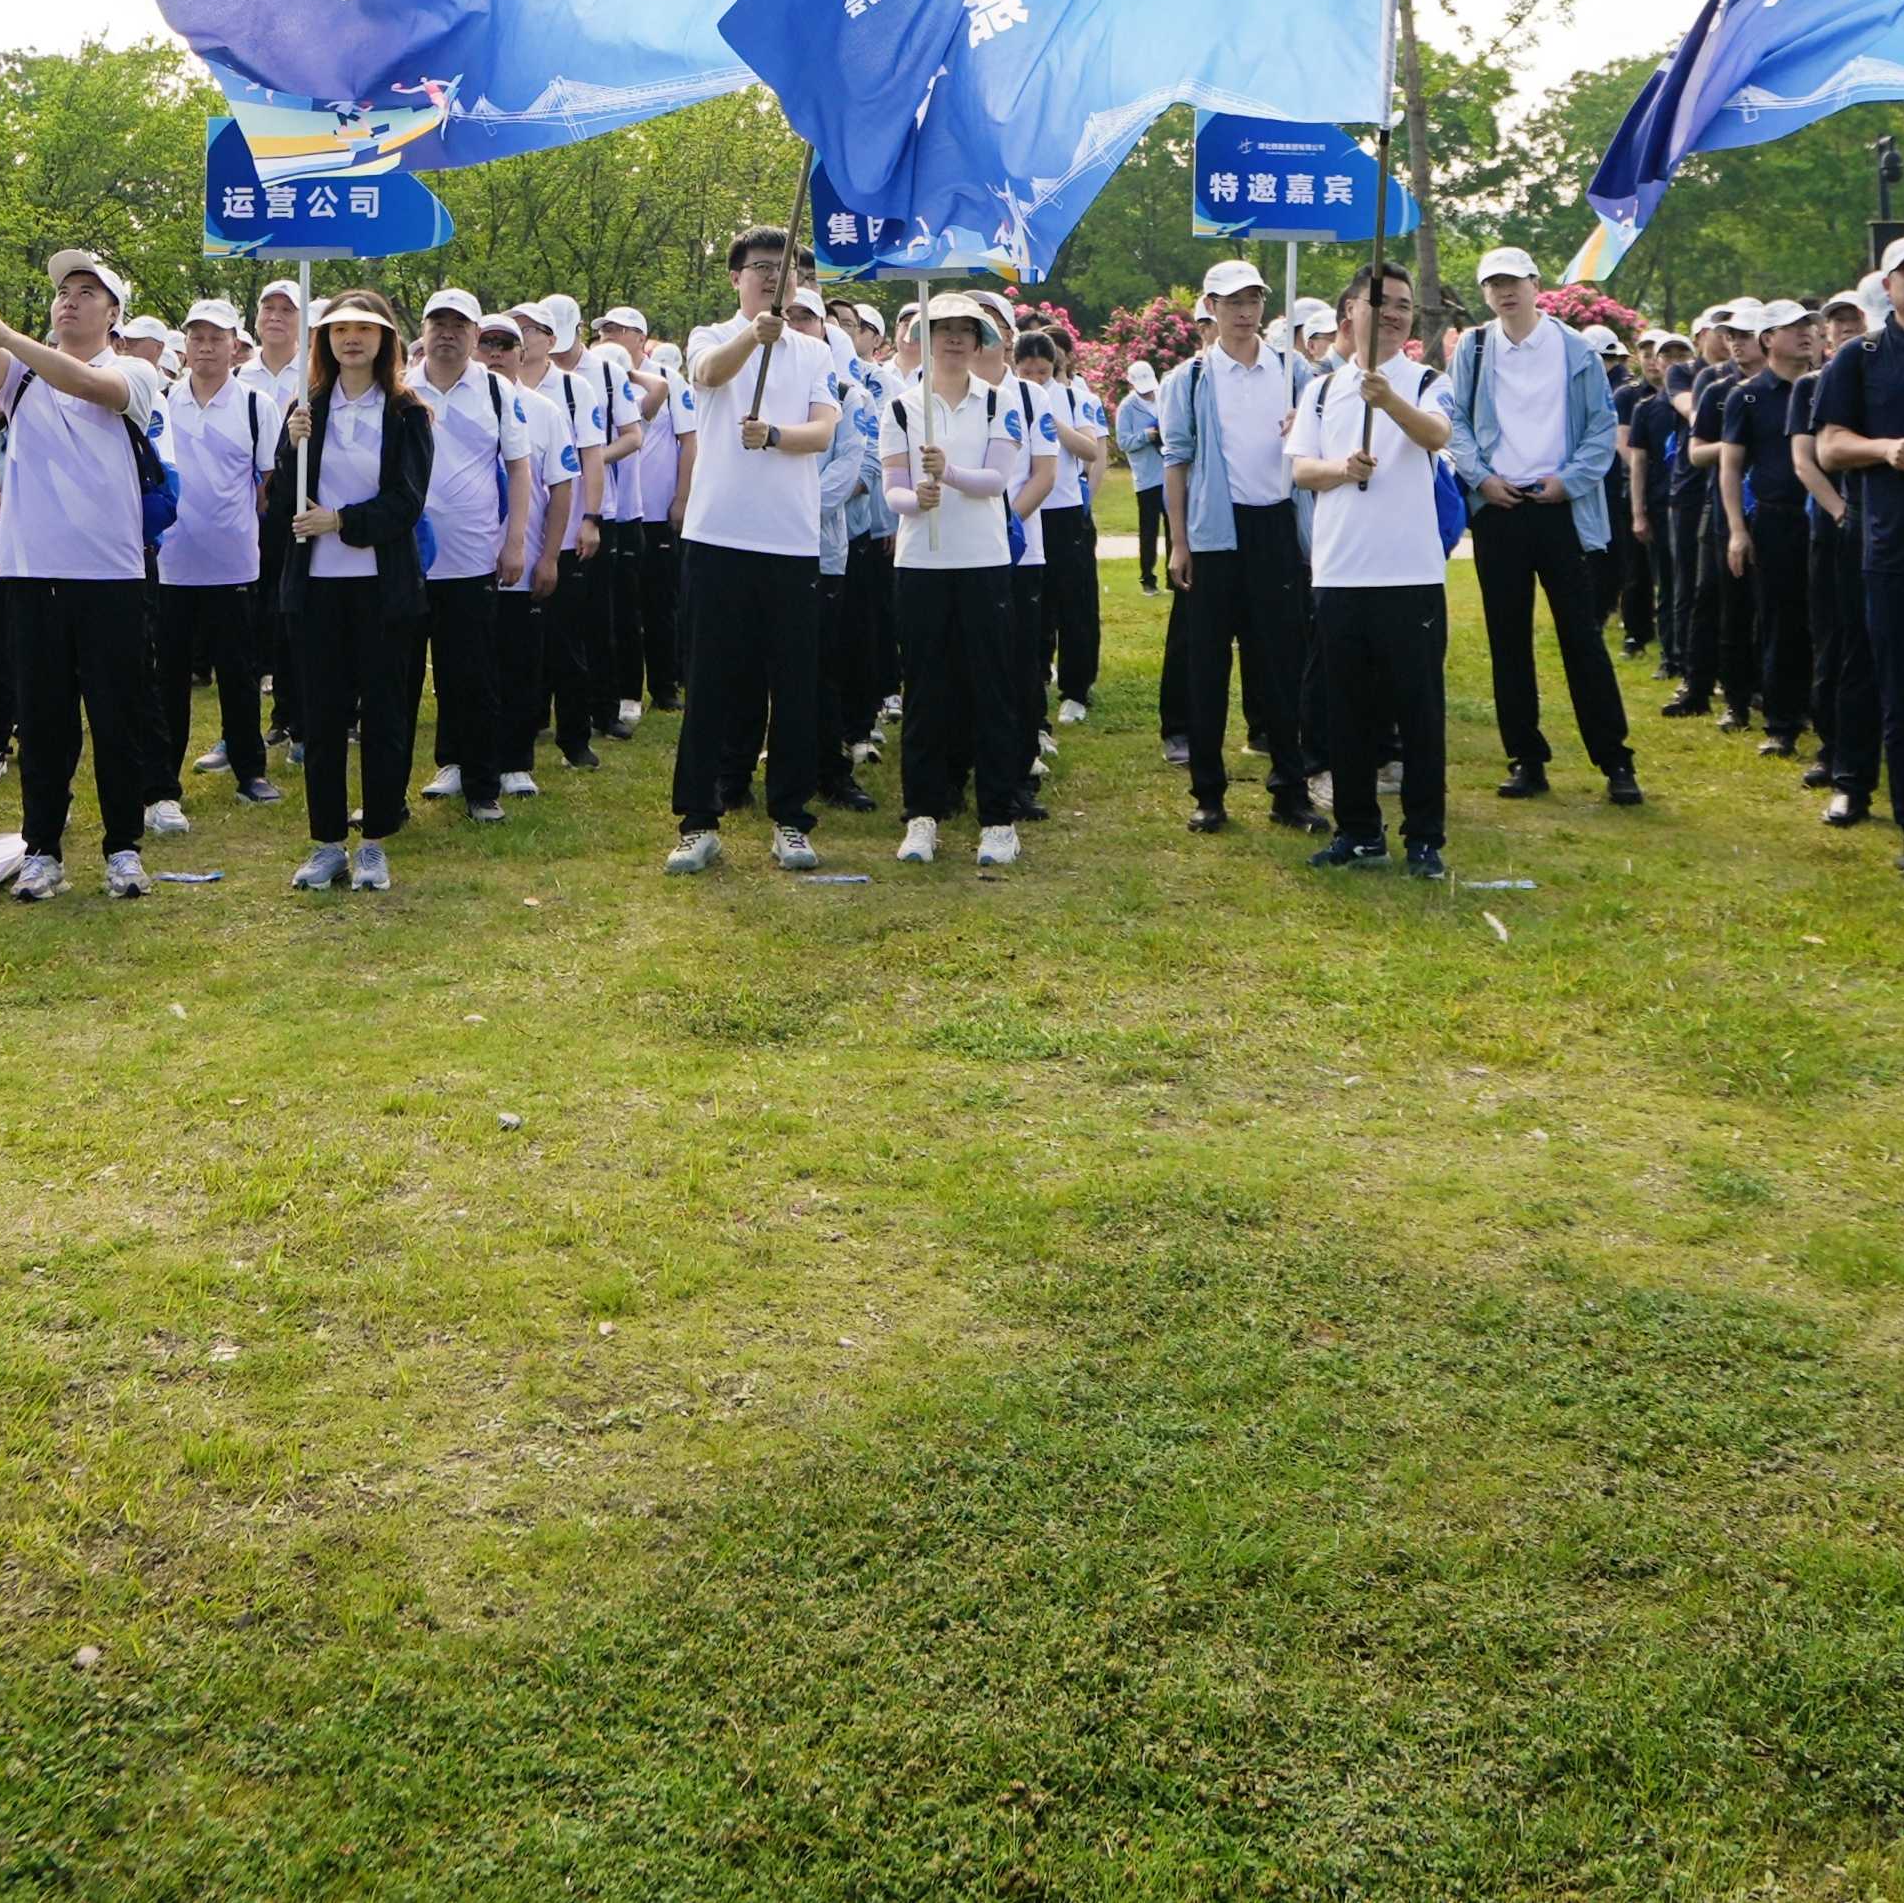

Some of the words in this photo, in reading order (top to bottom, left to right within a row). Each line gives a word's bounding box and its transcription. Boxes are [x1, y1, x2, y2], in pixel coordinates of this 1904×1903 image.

[222, 185, 381, 220] 运营公司
[1209, 172, 1354, 205] 特邀嘉宾
